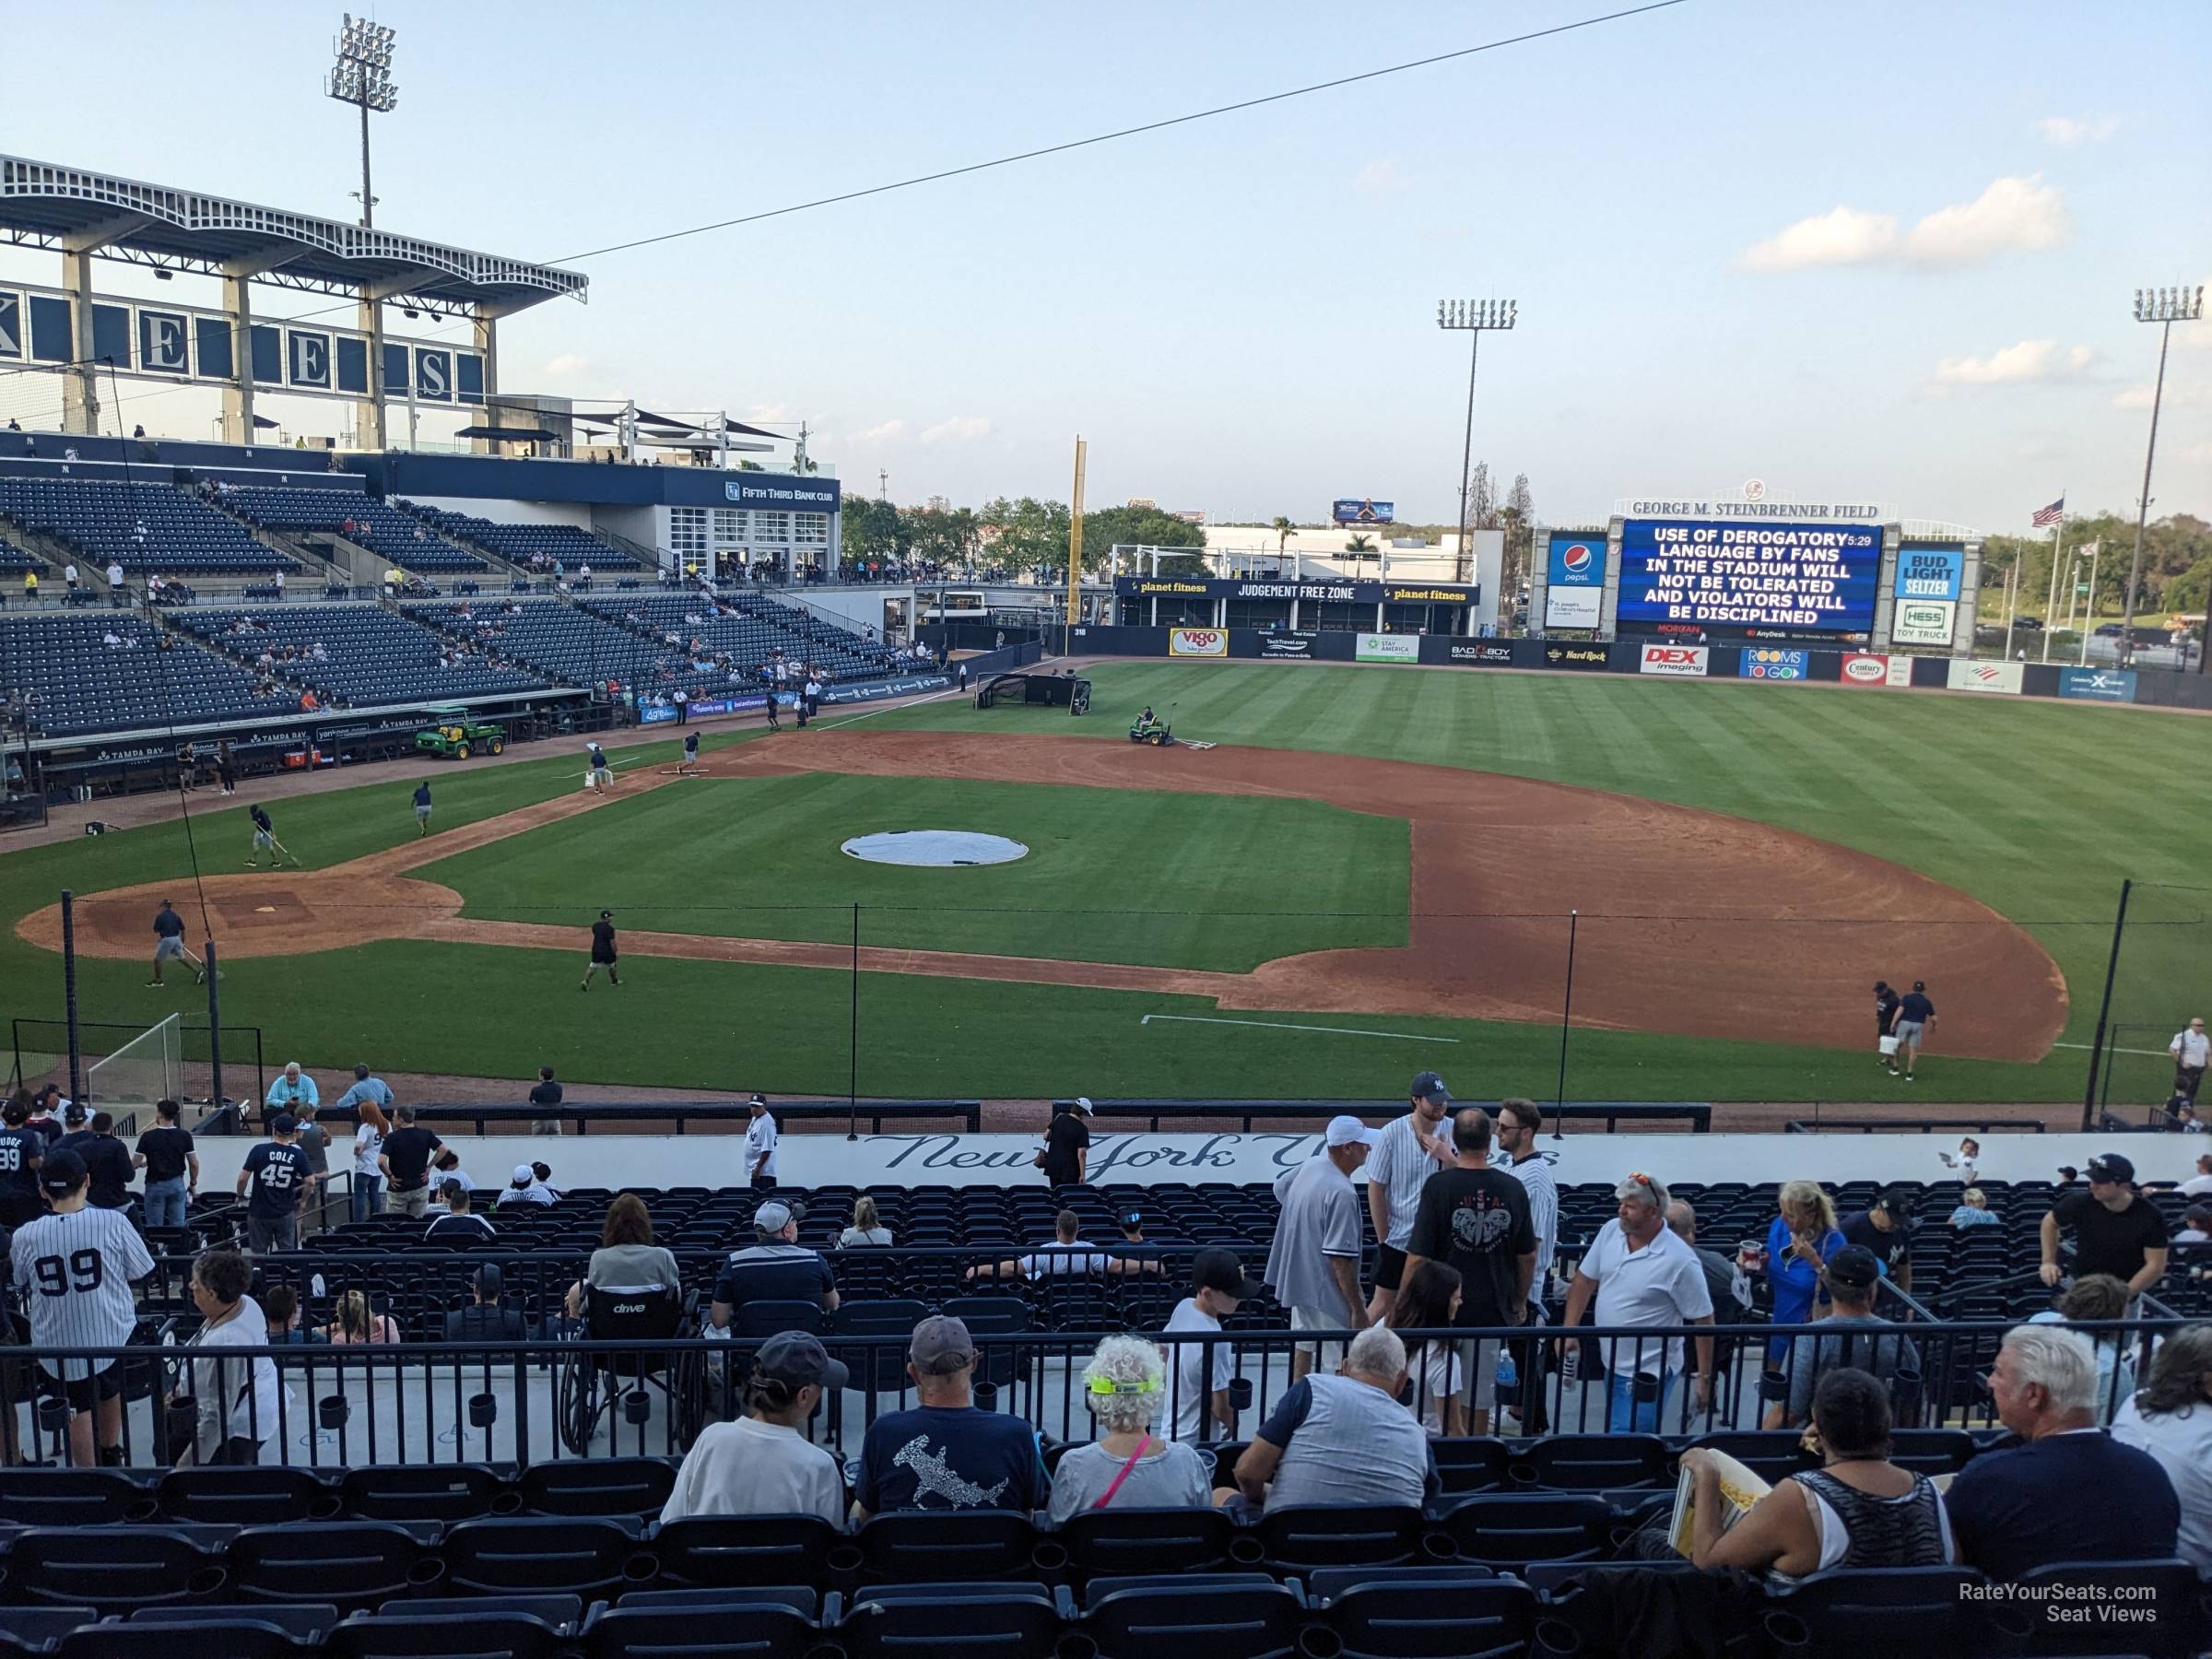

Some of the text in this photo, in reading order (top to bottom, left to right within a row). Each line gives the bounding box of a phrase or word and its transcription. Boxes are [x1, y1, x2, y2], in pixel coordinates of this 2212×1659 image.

[743, 488, 766, 499] FIFTH
[768, 488, 793, 500] THIRD
[794, 490, 817, 500] BANK
[817, 493, 833, 501] CLUB
[1633, 501, 1877, 519] GEORGE M. STEINBRENNER FIELD
[1654, 528, 1848, 547] USE OF DEROGATORY
[1847, 535, 1871, 547] 5:29
[1659, 544, 1840, 562] LANGUAGE BY FANS
[1912, 556, 1947, 568] BUD
[1646, 559, 1851, 579] IN THE STADIUM WILL
[1903, 568, 1954, 580] LIGHT
[1141, 582, 1206, 593] planet fitness
[1659, 574, 1834, 594] NOT BE TOLERATED
[1905, 579, 1948, 595] SELTZER
[1239, 584, 1354, 599] JUDGEMENT FREE ZONE
[1394, 588, 1466, 601] planet fitness
[1644, 590, 1846, 610] AND VIOLATORS WILL
[1669, 606, 1818, 624] BE DISCIPLINED
[1907, 610, 1942, 622] HESS
[1757, 629, 1786, 639] AnyDesk
[1897, 629, 1947, 639] TOY TRUCK
[1452, 646, 1475, 654] BAD
[1566, 651, 1586, 660] Hard
[1587, 652, 1606, 662] Rock
[1645, 649, 1700, 664] DEX
[1748, 650, 1801, 663] ROOMS
[1748, 665, 1792, 678] TO GO
[1849, 664, 1881, 674] Century
[390, 720, 411, 729] TAMPA
[262, 731, 307, 742] TAMPA BAY
[112, 747, 164, 759] TAMPA BAY
[269, 1151, 295, 1164] COLE
[864, 1135, 1041, 1169] New
[260, 1163, 294, 1188] 45
[35, 1247, 102, 1297] 99
[613, 1303, 645, 1313] drive
